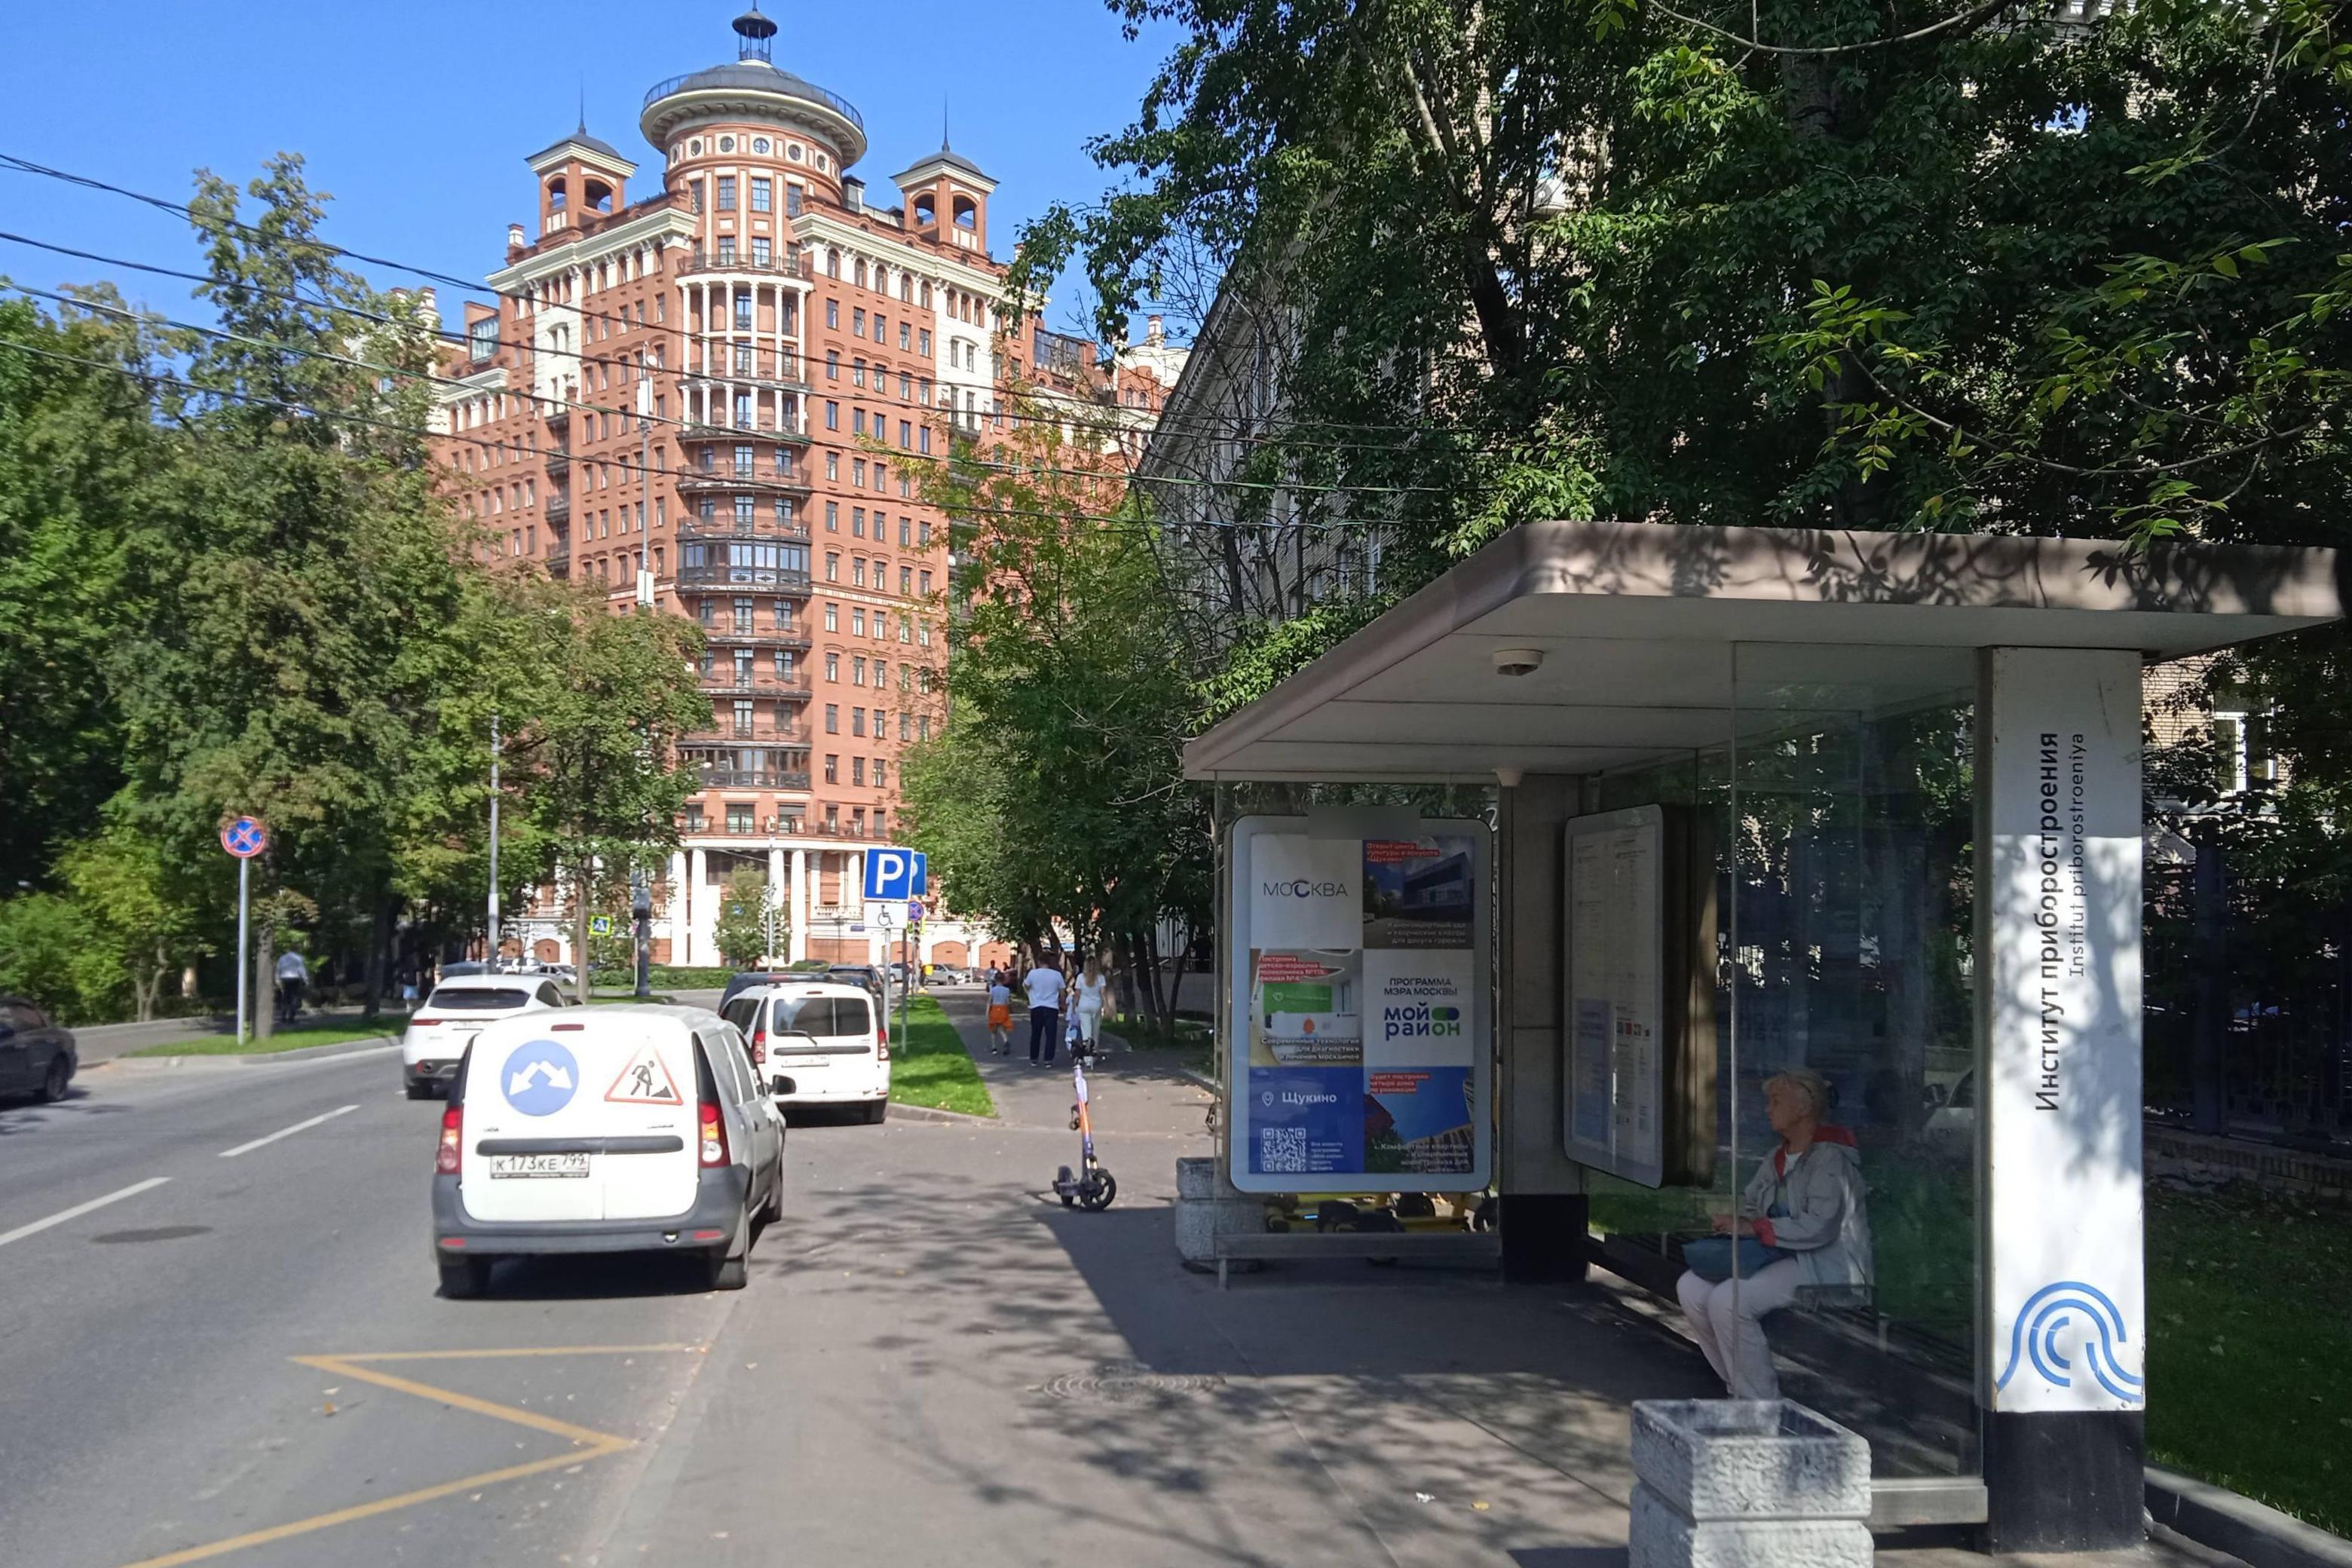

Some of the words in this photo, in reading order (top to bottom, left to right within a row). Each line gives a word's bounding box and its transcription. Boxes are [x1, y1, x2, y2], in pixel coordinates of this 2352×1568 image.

[2069, 733, 2087, 897] priborostroeniya
[2035, 733, 2063, 982] приборостроения
[876, 853, 904, 894] P
[1263, 879, 1348, 898] МОСКВА
[2069, 902, 2084, 978] Institut
[1389, 978, 1451, 986] ПРОГРАММА
[1413, 988, 1457, 996] МОСКВЫ
[1384, 1002, 1429, 1021] мой
[2035, 987, 2064, 1112] Институт
[1282, 1092, 1337, 1104] Щукино
